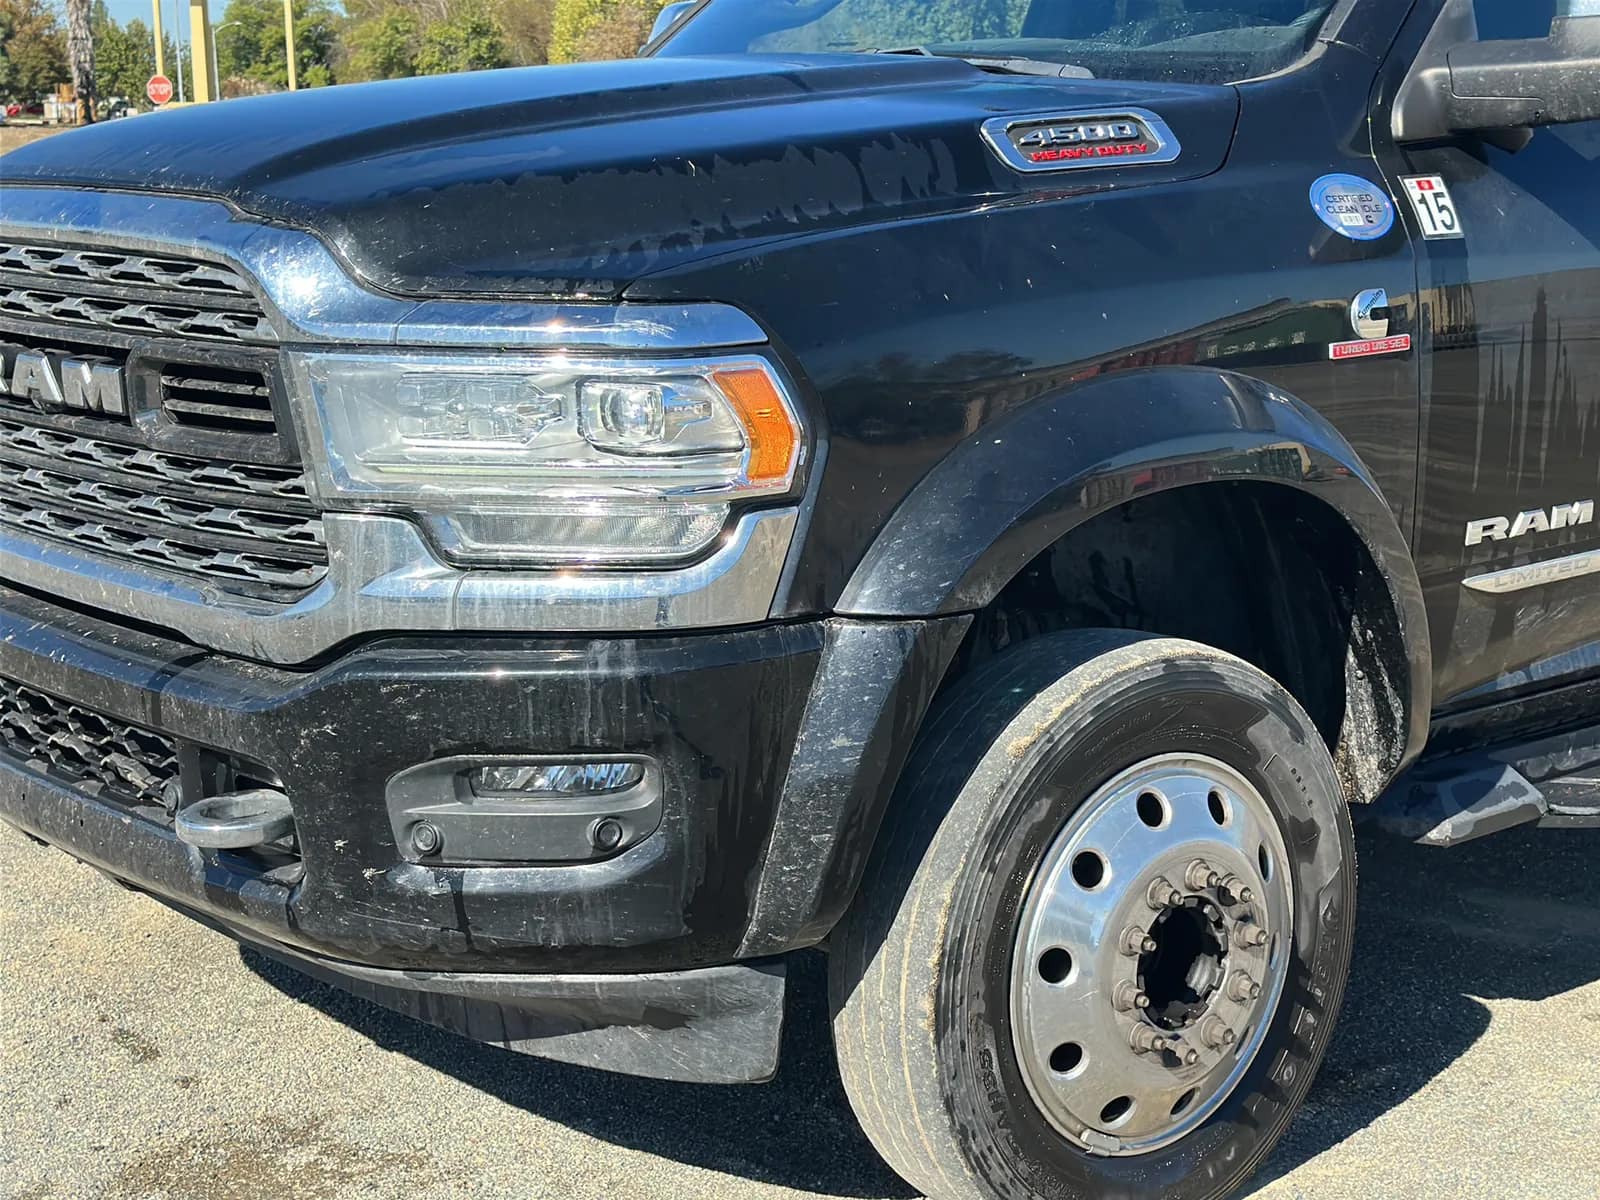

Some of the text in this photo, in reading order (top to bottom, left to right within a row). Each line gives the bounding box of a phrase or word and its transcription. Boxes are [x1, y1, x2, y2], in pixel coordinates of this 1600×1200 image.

[149, 83, 171, 96] STOP
[1018, 122, 1139, 147] 4500
[1029, 143, 1148, 162] HEAVY DUTY
[1325, 193, 1373, 203] CERTIFIED
[1325, 204, 1359, 214] CLEAN
[1417, 191, 1455, 231] 15
[1357, 289, 1384, 320] Cummins
[1334, 338, 1407, 356] TURBO DIESEL
[0, 351, 125, 414] AM
[1465, 499, 1594, 546] RAM
[1494, 558, 1591, 588] LIMITED
